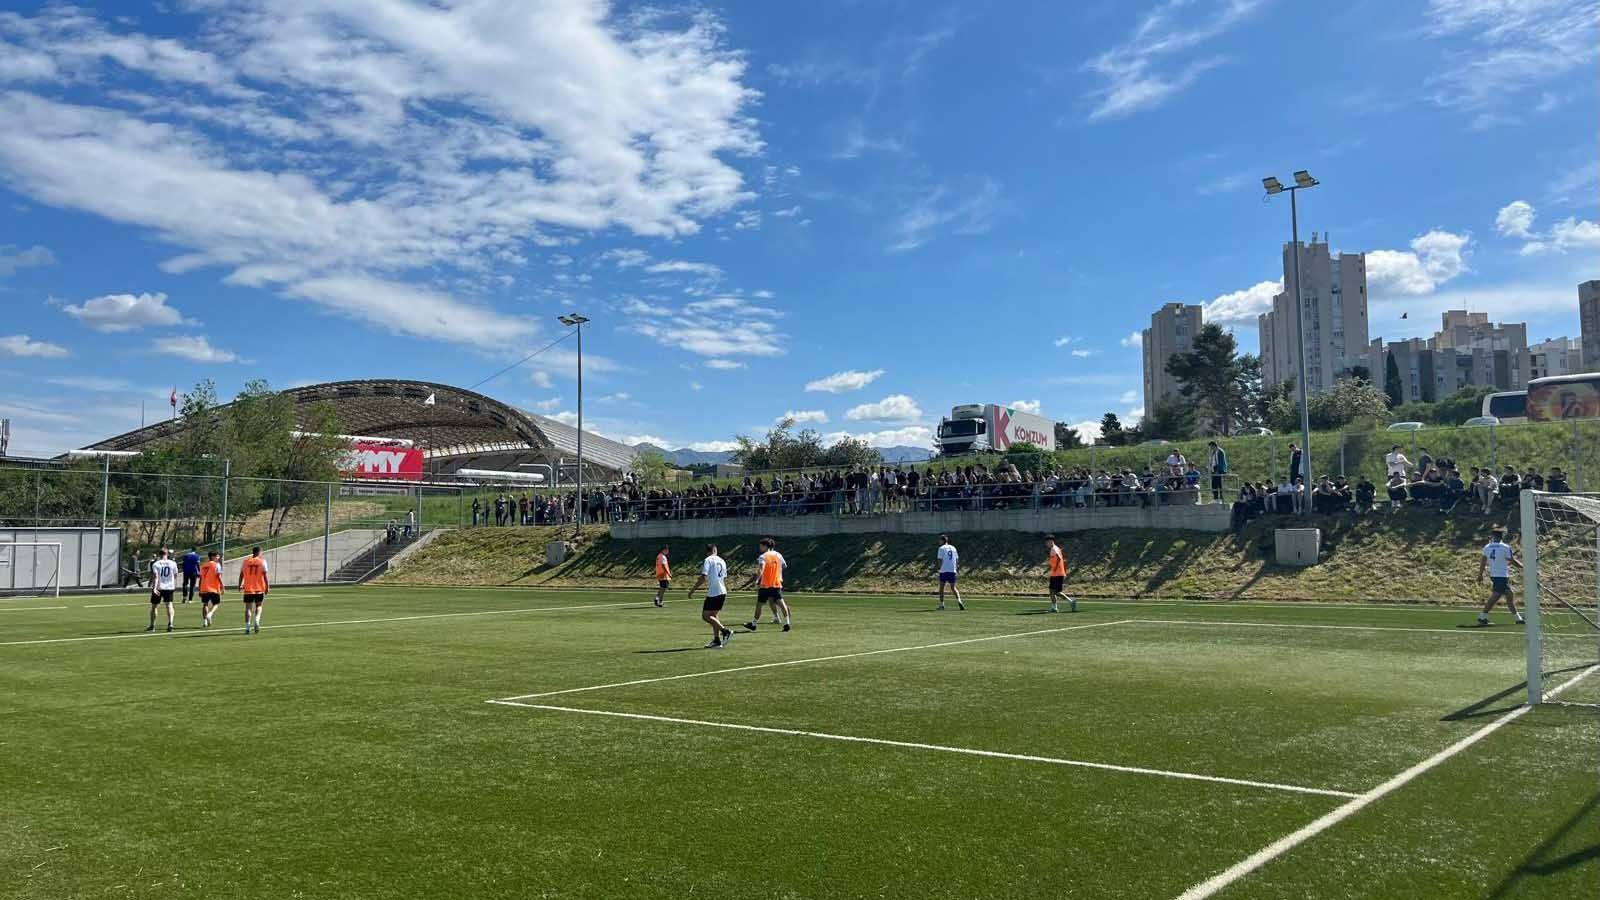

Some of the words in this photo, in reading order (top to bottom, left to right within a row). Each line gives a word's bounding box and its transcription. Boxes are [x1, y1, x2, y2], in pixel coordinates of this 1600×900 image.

[994, 405, 1011, 449] K
[1014, 425, 1047, 446] KONZUM
[947, 550, 953, 561] 9
[1489, 549, 1496, 561] 4
[161, 566, 170, 578] 10
